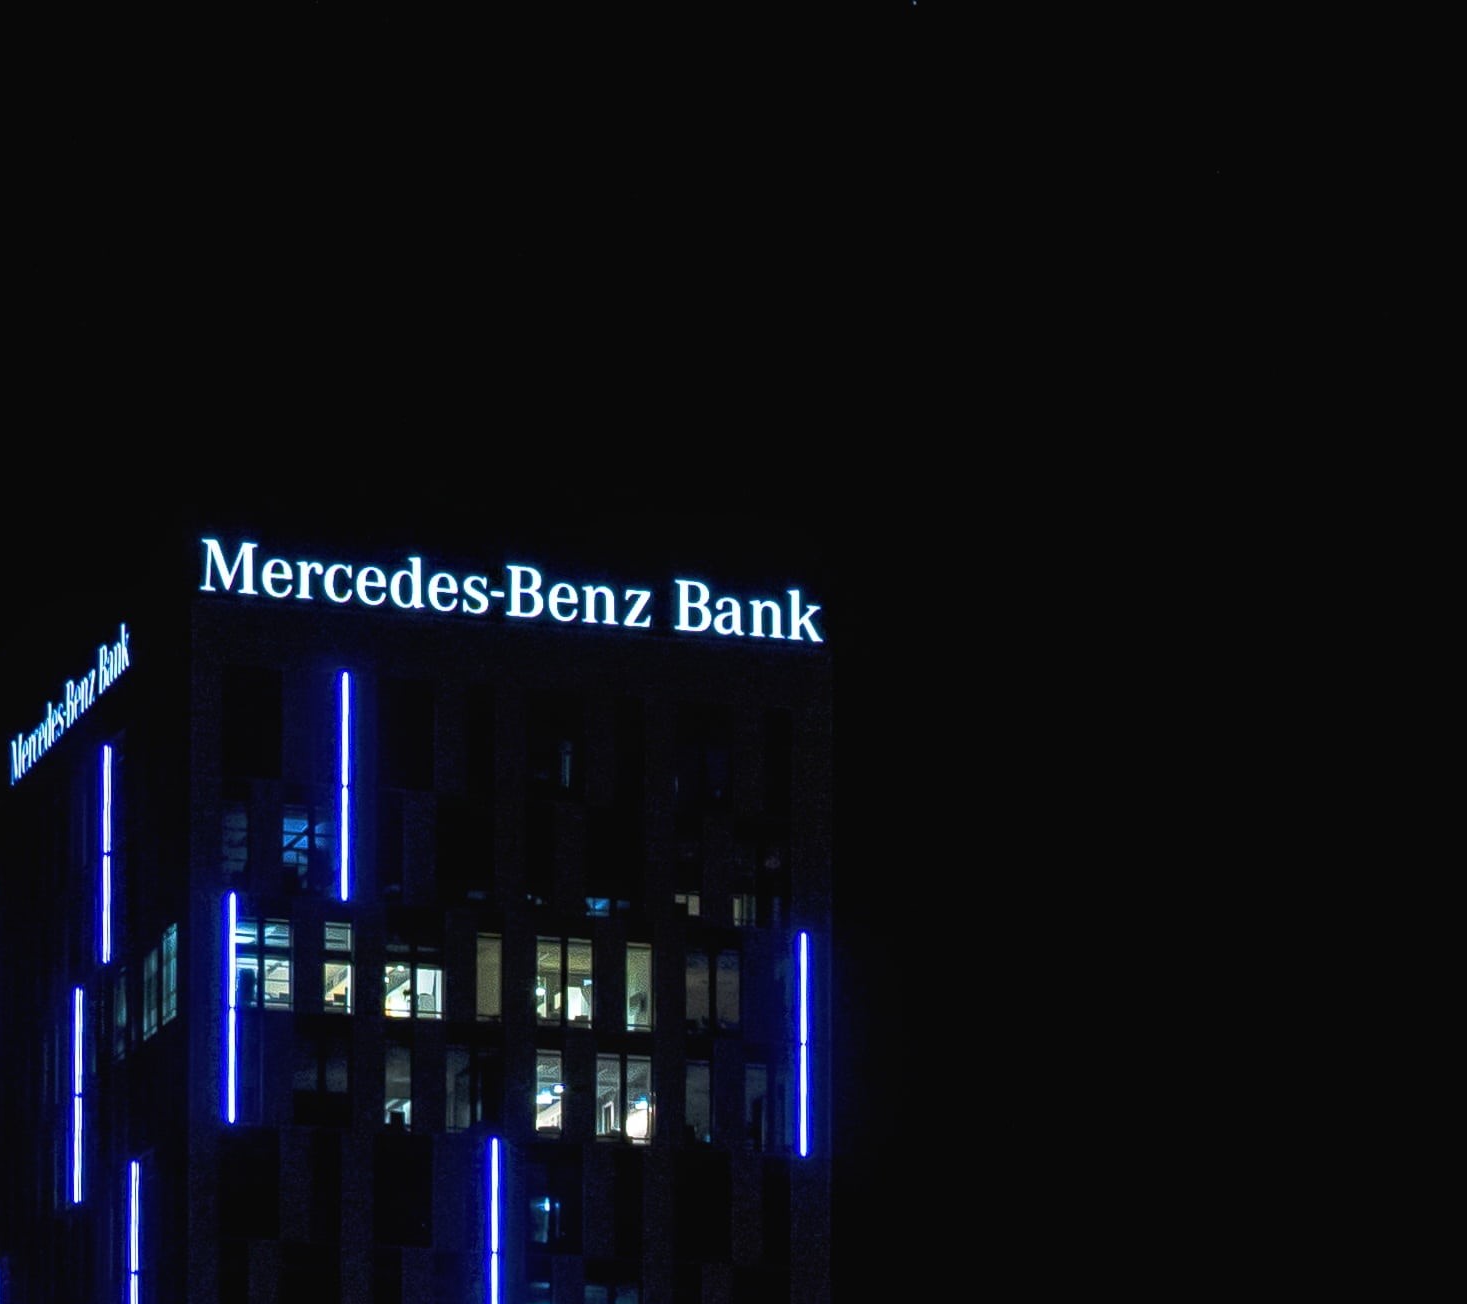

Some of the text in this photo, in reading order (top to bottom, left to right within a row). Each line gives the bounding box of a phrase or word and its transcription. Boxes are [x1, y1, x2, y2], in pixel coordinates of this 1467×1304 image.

[200, 539, 824, 643] Mercedes-Benz Bank
[11, 623, 130, 786] Mercedes-Benz Bank
